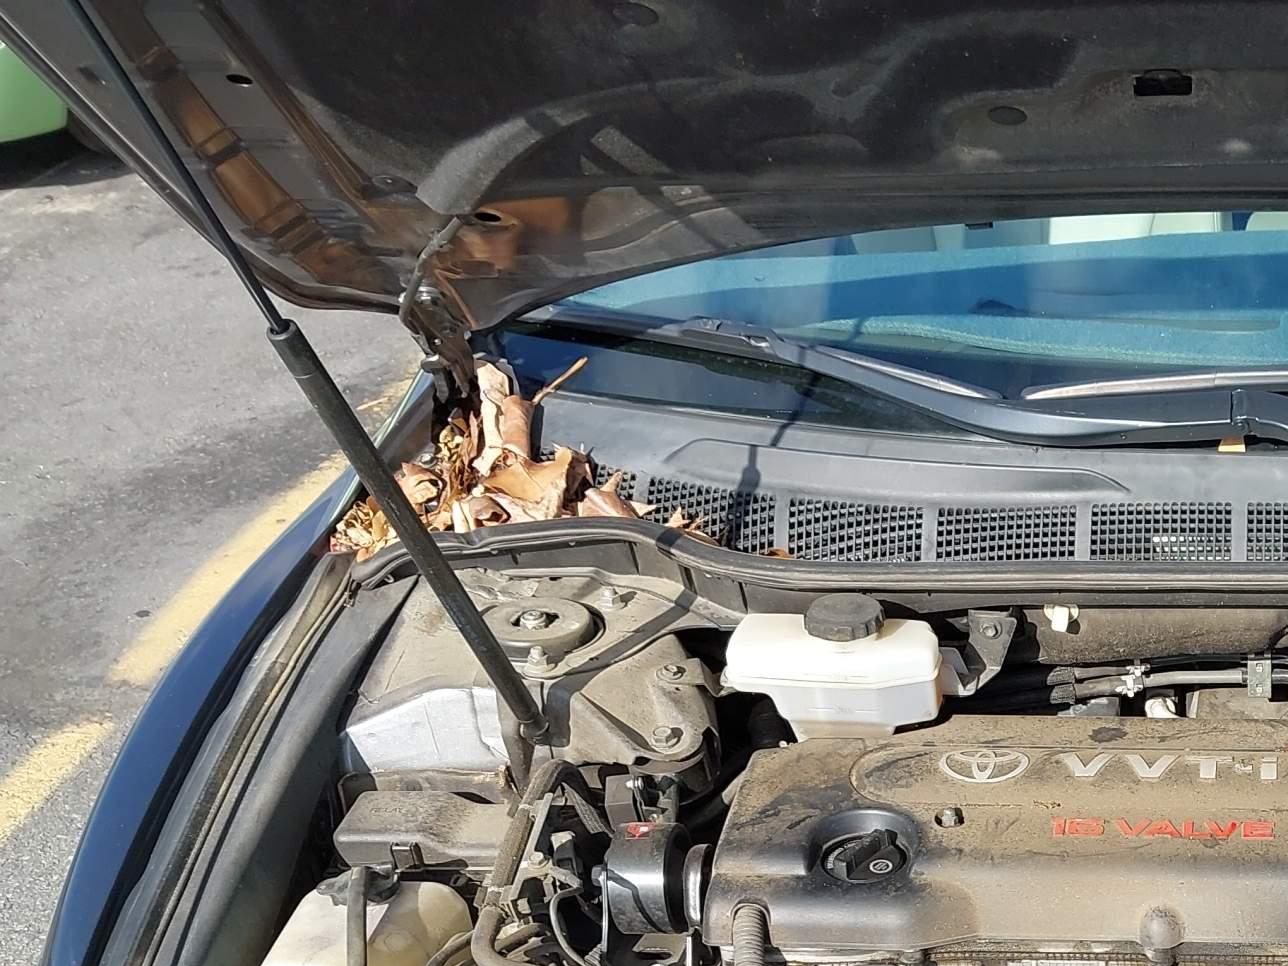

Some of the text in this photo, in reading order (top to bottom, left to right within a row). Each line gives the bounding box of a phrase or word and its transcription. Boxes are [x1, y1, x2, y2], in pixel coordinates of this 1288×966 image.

[1061, 752, 1279, 780] VVT-i
[1052, 816, 1276, 839] 16 VALVE
